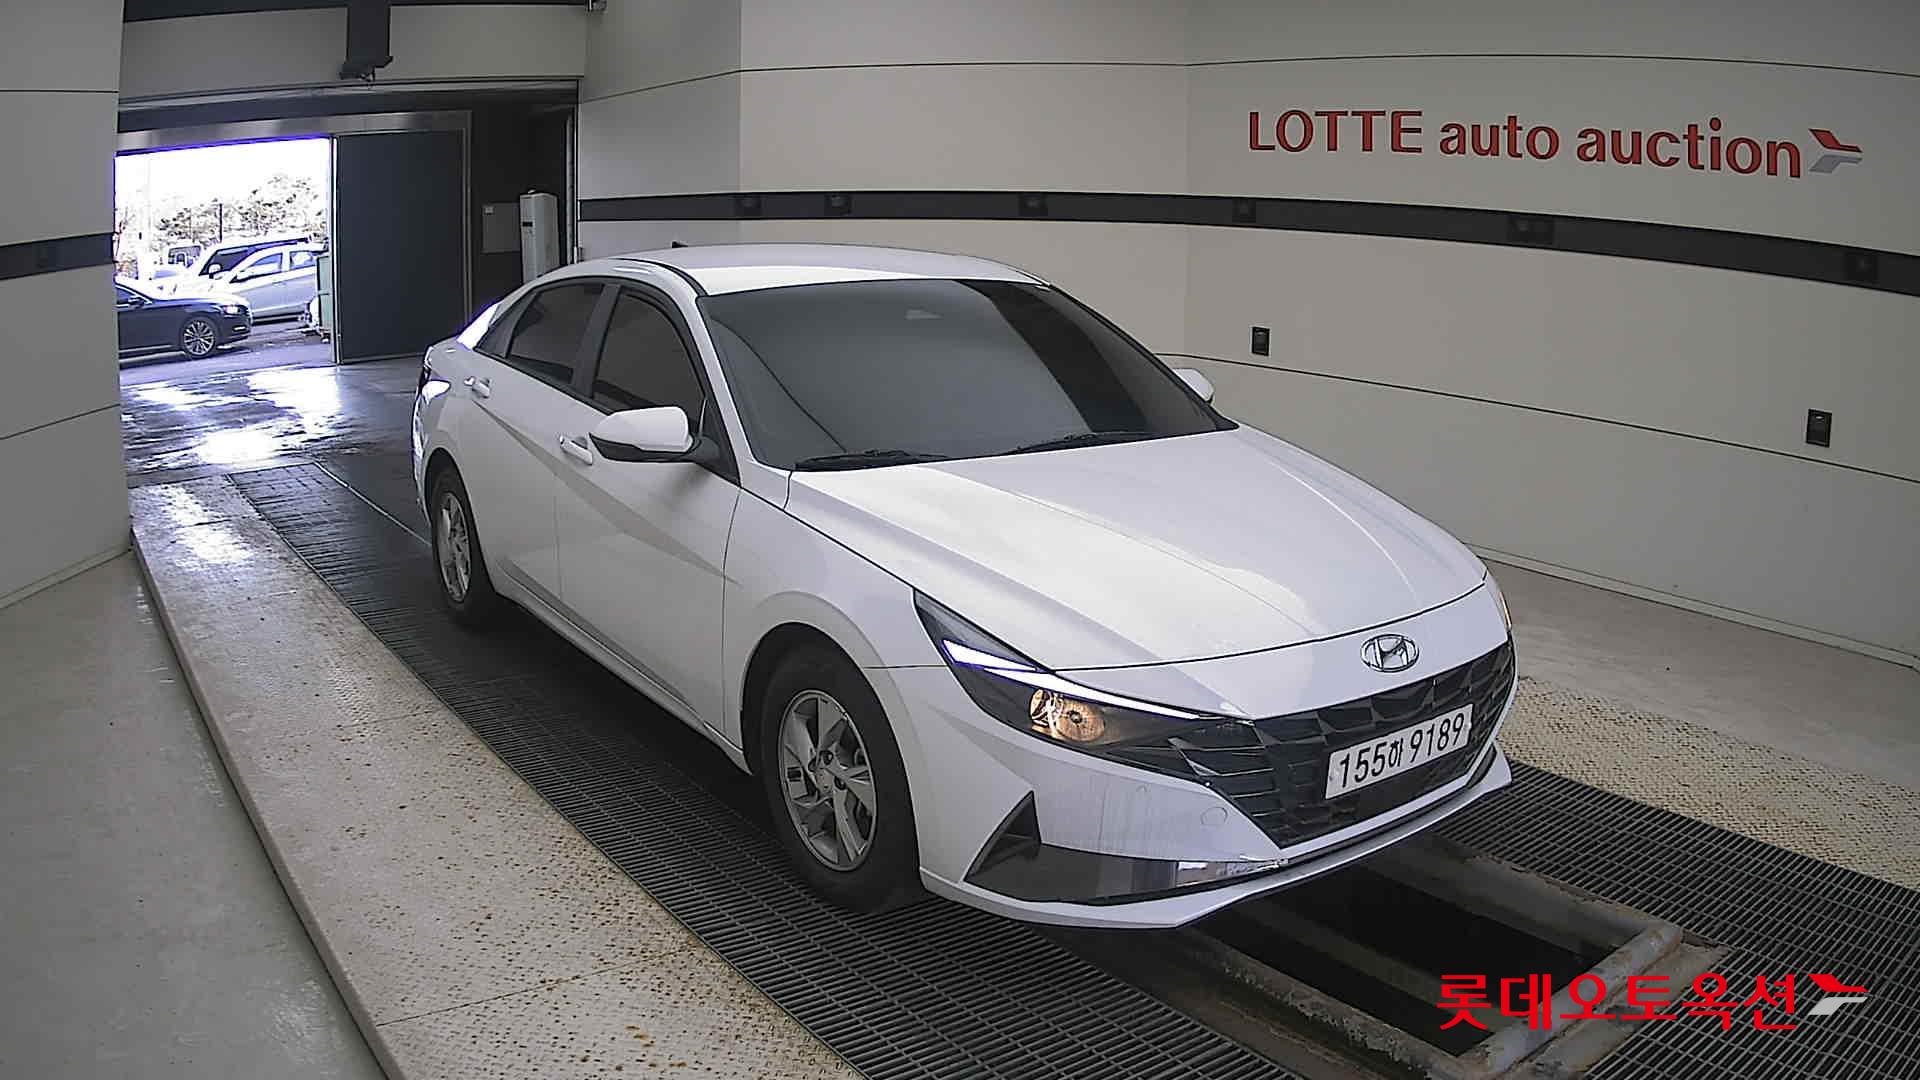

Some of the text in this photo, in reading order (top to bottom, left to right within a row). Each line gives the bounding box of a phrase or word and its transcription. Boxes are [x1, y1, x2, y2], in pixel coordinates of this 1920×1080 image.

[1248, 110, 1801, 179] LOTTE auto auction
[1410, 712, 1465, 763] 9189
